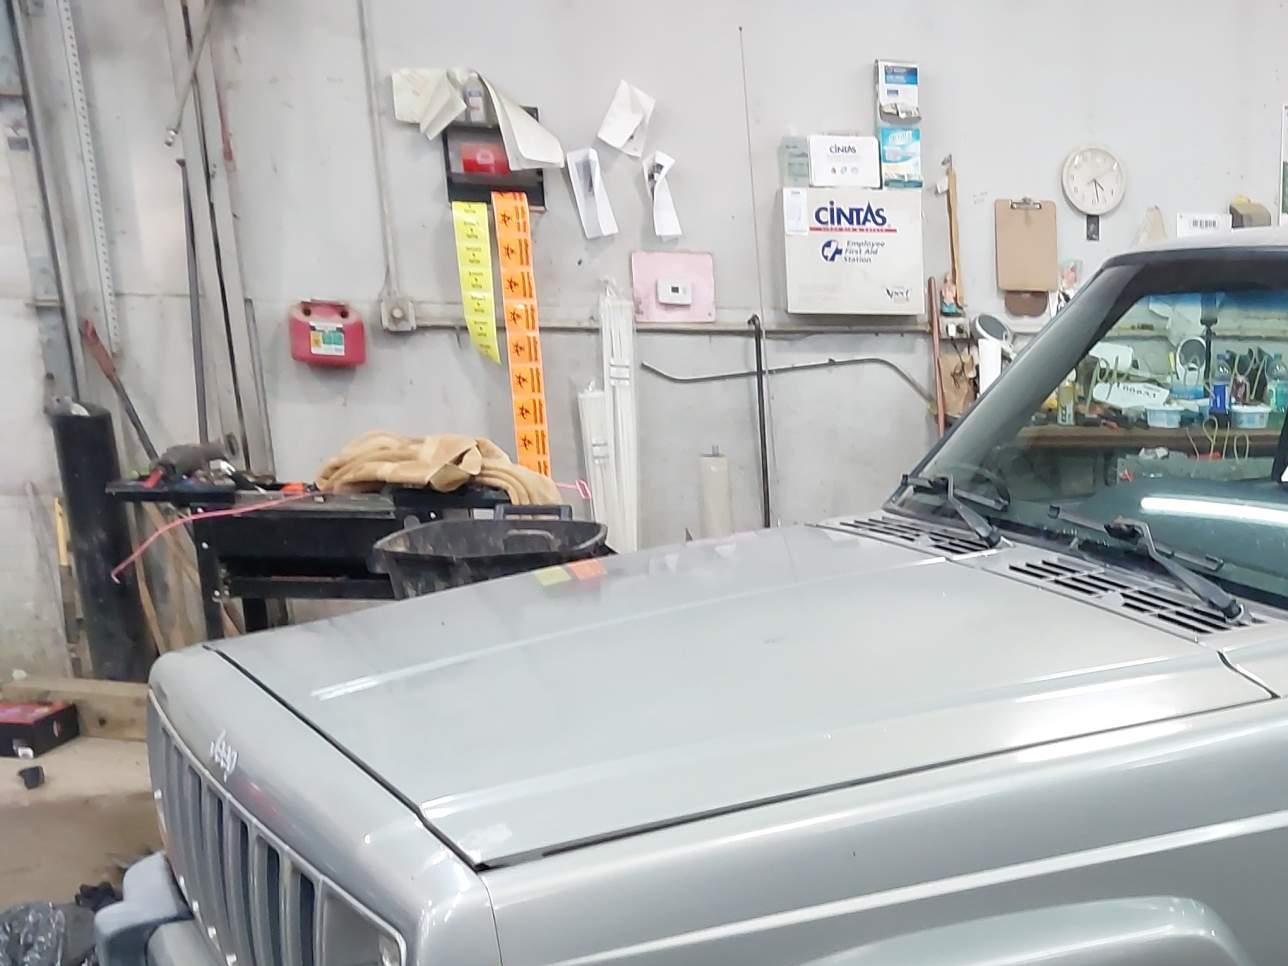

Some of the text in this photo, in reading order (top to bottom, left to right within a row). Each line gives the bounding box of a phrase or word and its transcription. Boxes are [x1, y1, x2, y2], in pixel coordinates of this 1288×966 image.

[829, 143, 857, 154] CINTAS
[814, 200, 888, 227] CINTAS
[846, 240, 886, 250] Employee
[844, 248, 879, 256] First Aid
[844, 256, 872, 264] Station
[210, 730, 239, 782] Jeep
